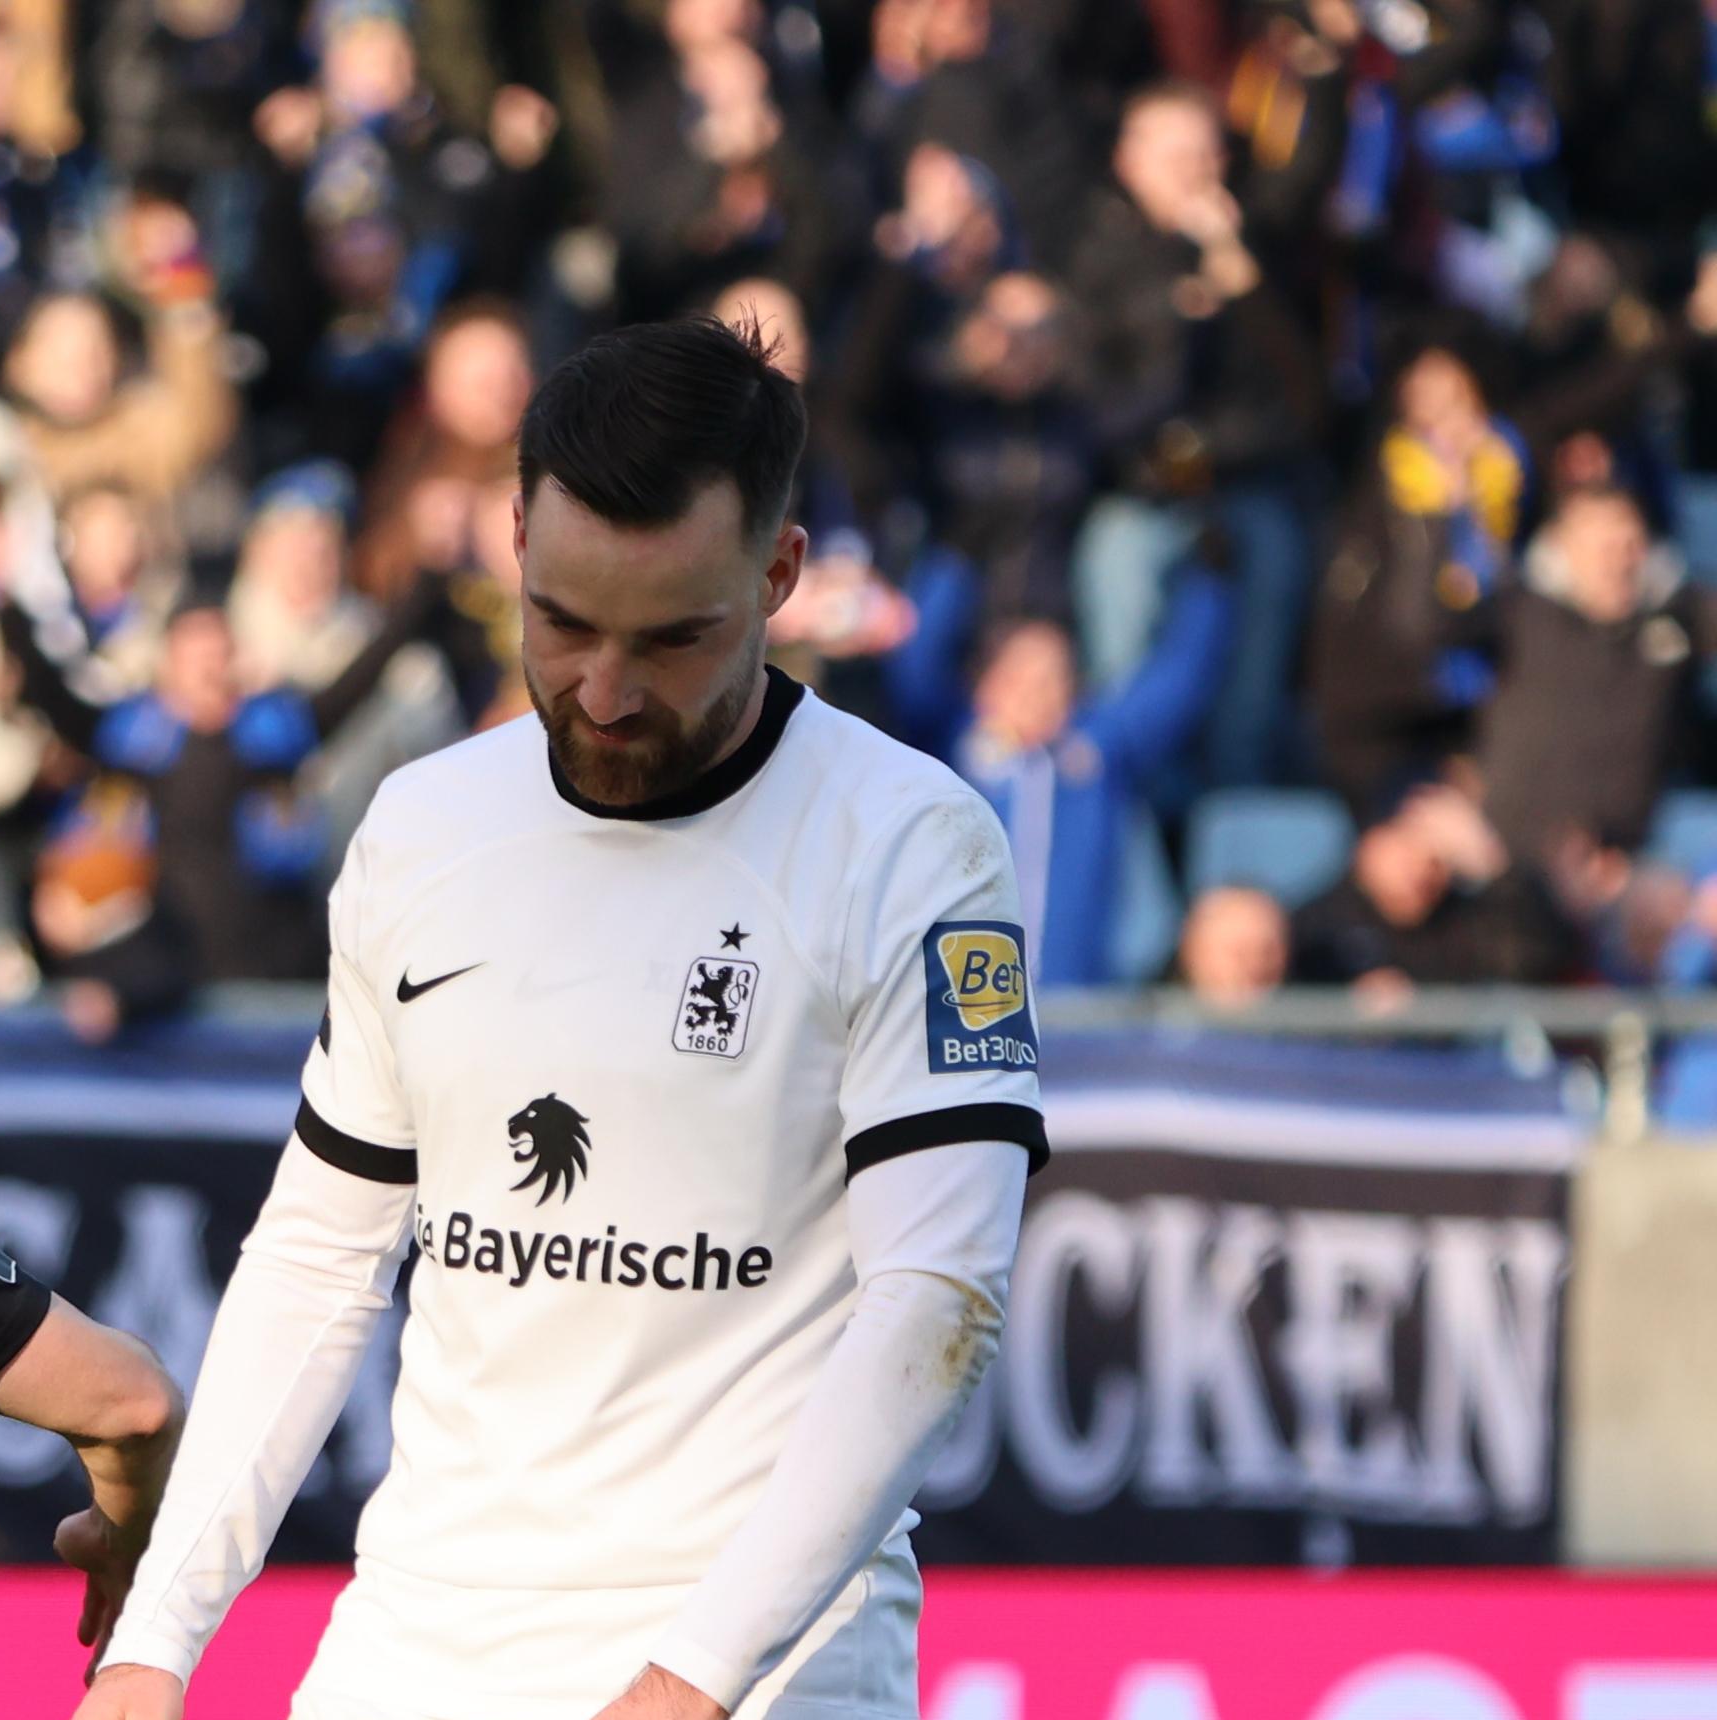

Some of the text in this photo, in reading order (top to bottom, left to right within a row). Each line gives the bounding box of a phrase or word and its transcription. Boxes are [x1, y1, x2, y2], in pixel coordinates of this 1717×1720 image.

[959, 949, 1026, 996] Bet
[687, 1034, 728, 1052] 1860
[943, 1035, 1037, 1065] Bet3000
[444, 1211, 773, 1291] Bayerische
